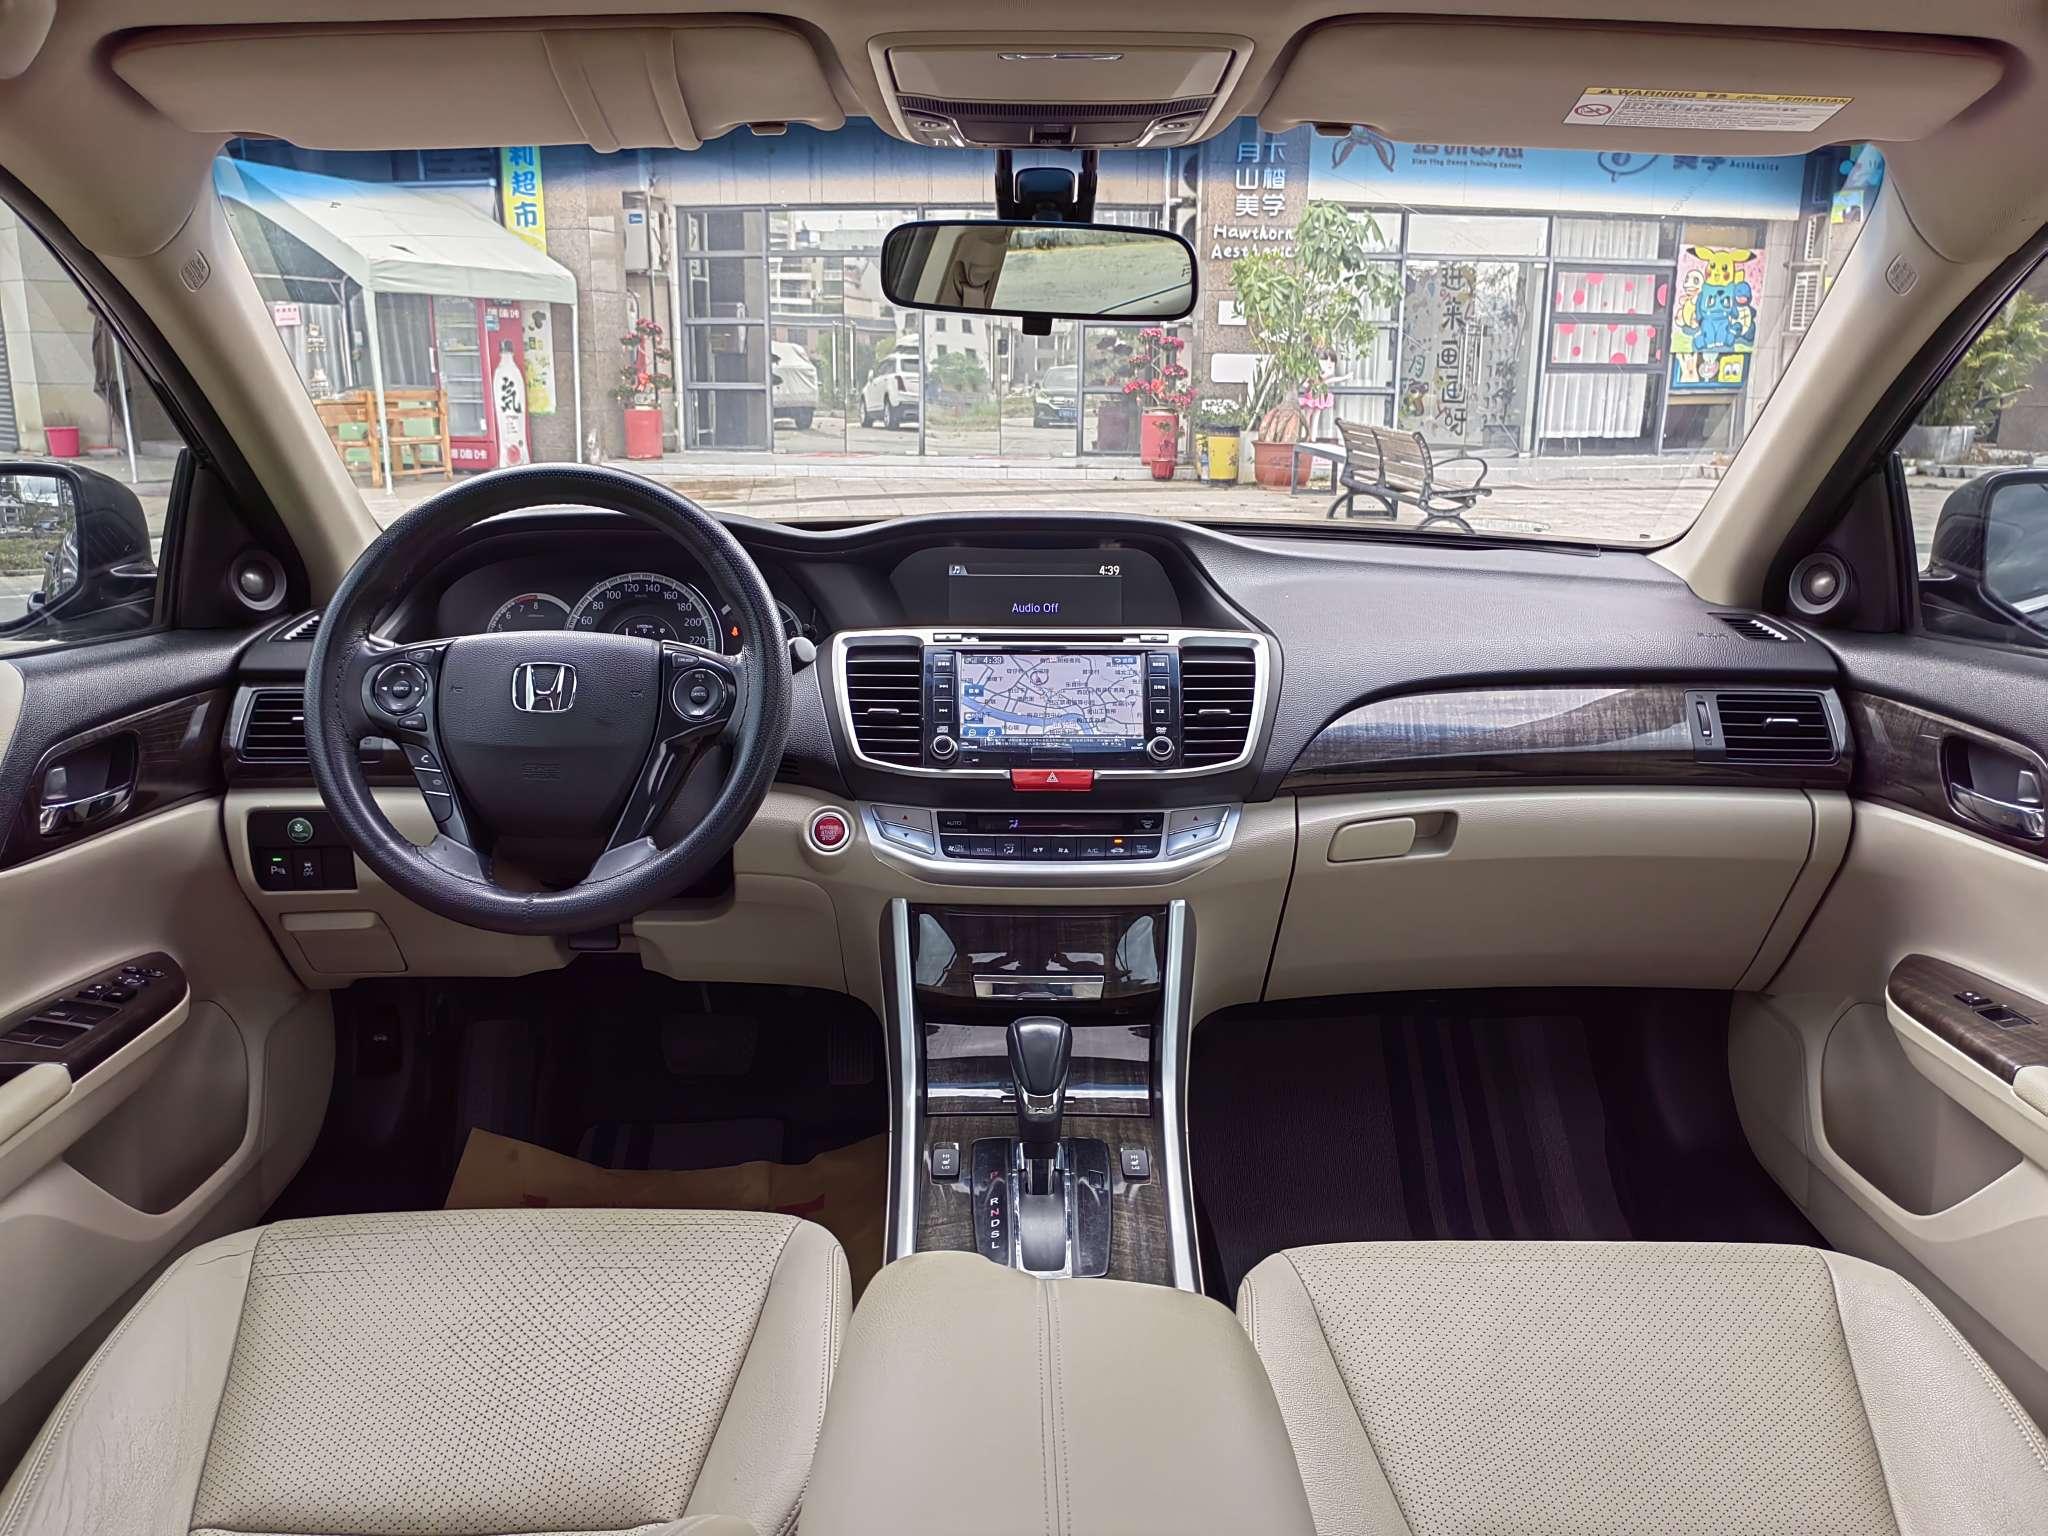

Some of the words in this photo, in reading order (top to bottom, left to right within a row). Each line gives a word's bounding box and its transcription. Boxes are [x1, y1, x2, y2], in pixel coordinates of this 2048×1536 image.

[1618, 89, 1697, 98] WARNING
[1237, 142, 1287, 163] 月下
[1235, 194, 1286, 217] 美学
[1099, 566, 1120, 576] 4:39
[624, 583, 639, 592] 120
[645, 583, 661, 592] 140
[606, 590, 621, 600] 100
[664, 591, 678, 600] 160
[533, 602, 539, 610] 8
[592, 602, 604, 610] 80
[677, 602, 692, 612] 180
[1012, 603, 1040, 613] Audio
[1043, 602, 1059, 613] Off
[505, 611, 512, 620] 6
[581, 615, 593, 625] 60
[684, 617, 701, 627] 200
[689, 636, 706, 645] 220
[990, 1197, 999, 1206] R
[990, 1208, 1000, 1217] N
[990, 1219, 1000, 1228] D
[990, 1230, 1000, 1239] S
